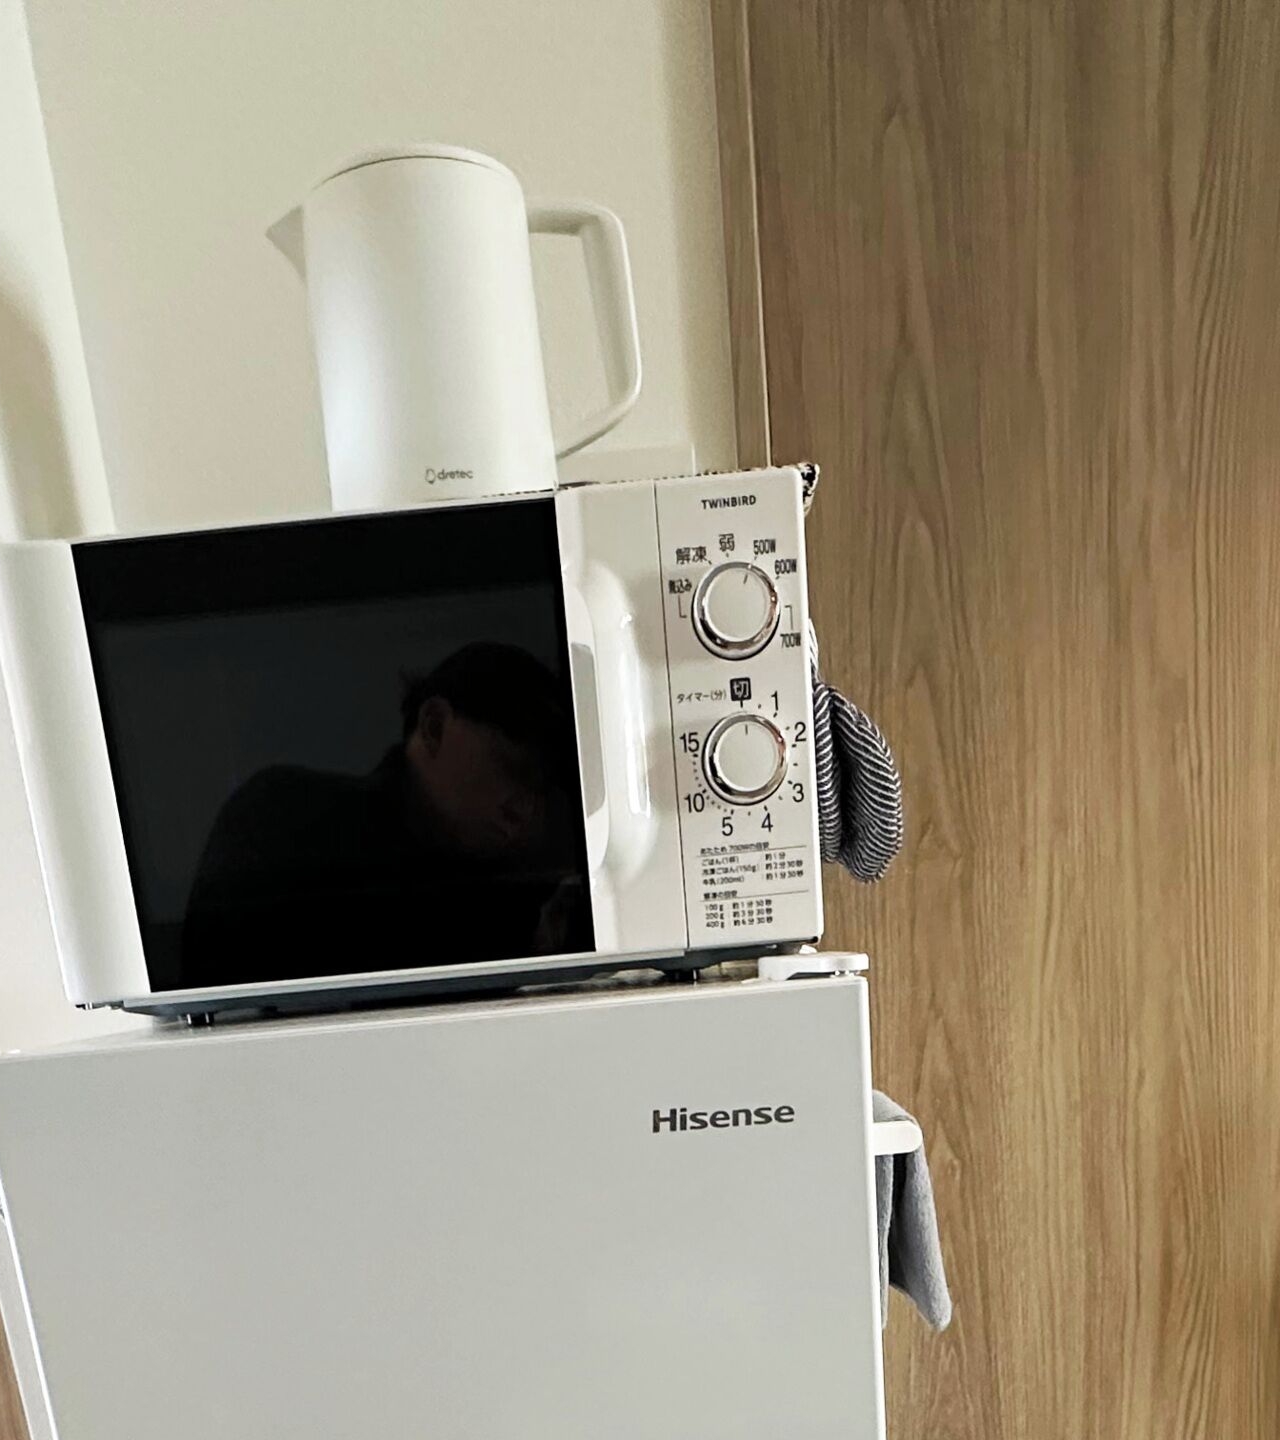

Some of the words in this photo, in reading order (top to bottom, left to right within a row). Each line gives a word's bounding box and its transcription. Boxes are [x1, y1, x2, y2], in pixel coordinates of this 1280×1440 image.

[701, 495, 756, 510] TWINBIRD
[719, 533, 735, 552] 弱
[753, 539, 776, 555] 500W
[676, 546, 707, 565] 解凍
[774, 558, 797, 575] 600W
[780, 632, 801, 648] 700W
[732, 680, 750, 699] 切
[771, 691, 779, 711] 1
[795, 722, 807, 742] 2
[679, 732, 700, 752] 15
[792, 783, 805, 802] 3
[684, 793, 705, 813] 10
[721, 816, 733, 836] 5
[761, 812, 773, 832] 4
[652, 1105, 795, 1133] Hisense
